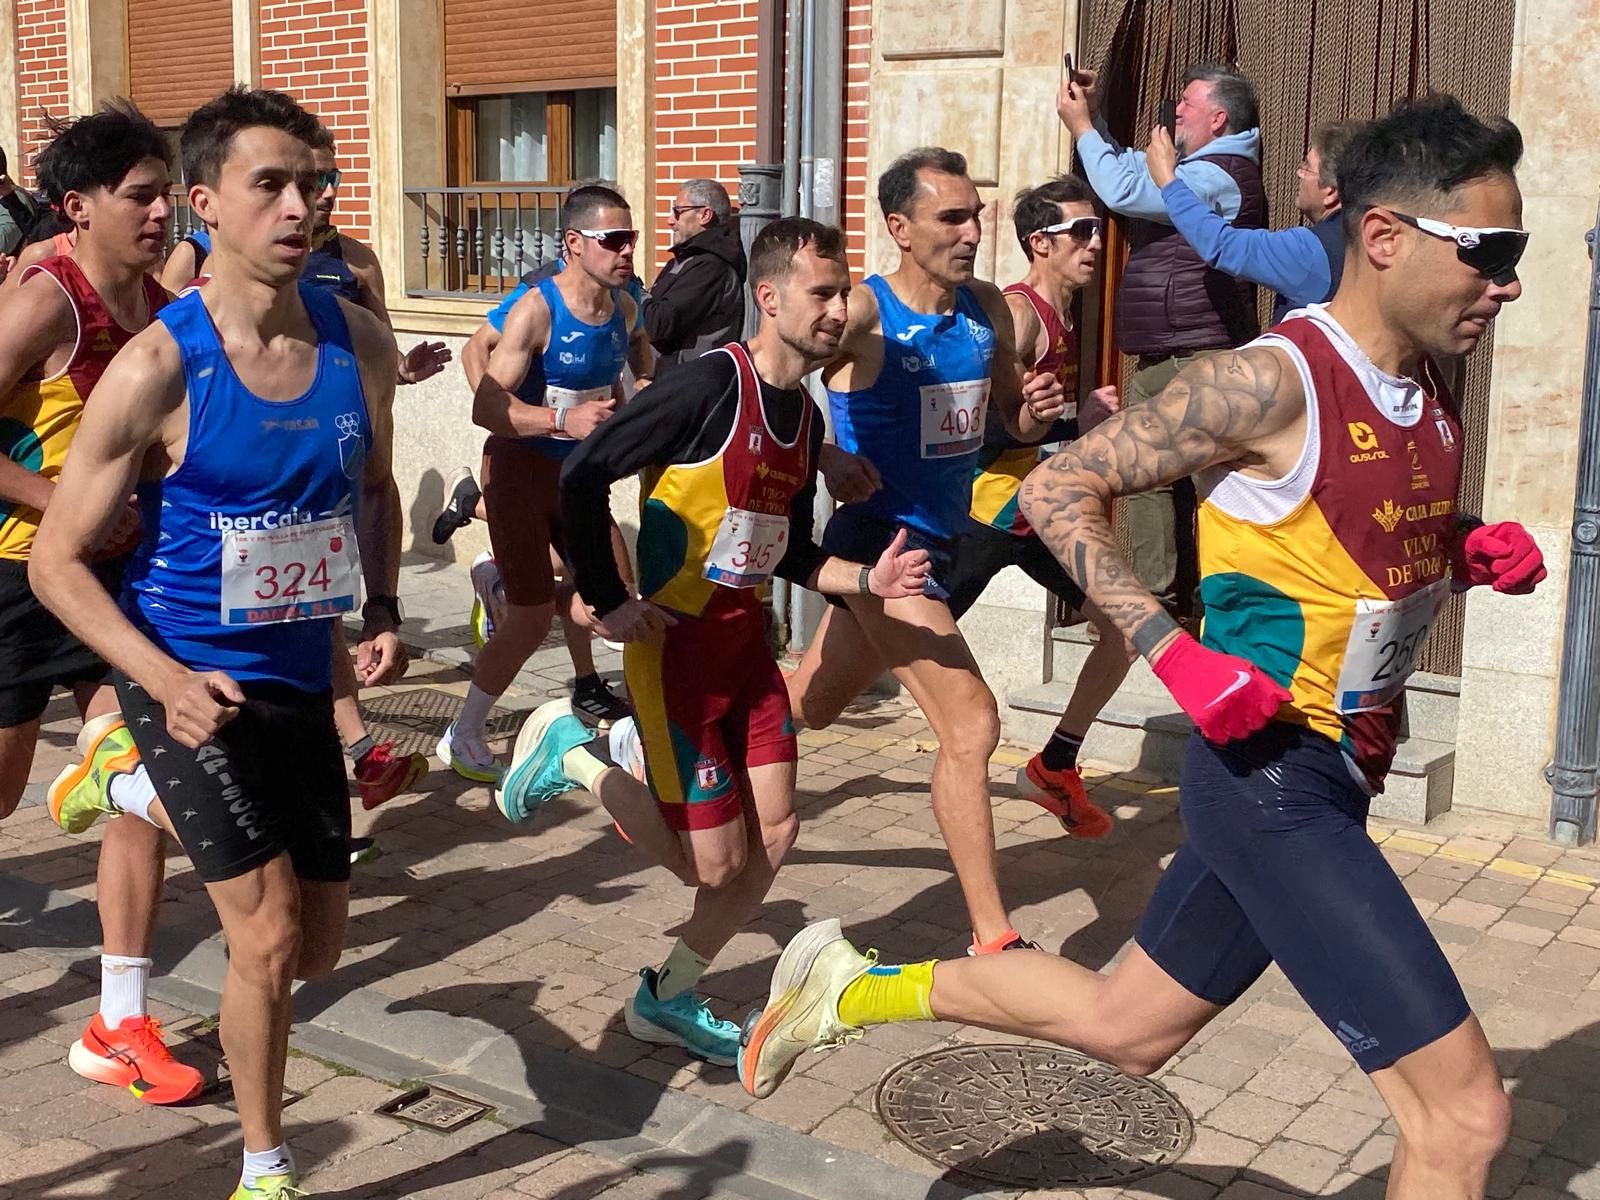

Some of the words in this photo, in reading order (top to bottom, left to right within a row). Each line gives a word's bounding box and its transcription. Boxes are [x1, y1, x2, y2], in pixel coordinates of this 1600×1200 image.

[940, 406, 981, 436] 403
[209, 506, 312, 530] iberCaja
[731, 541, 775, 568] 345
[255, 557, 332, 600] 324
[1386, 564, 1413, 587] DE
